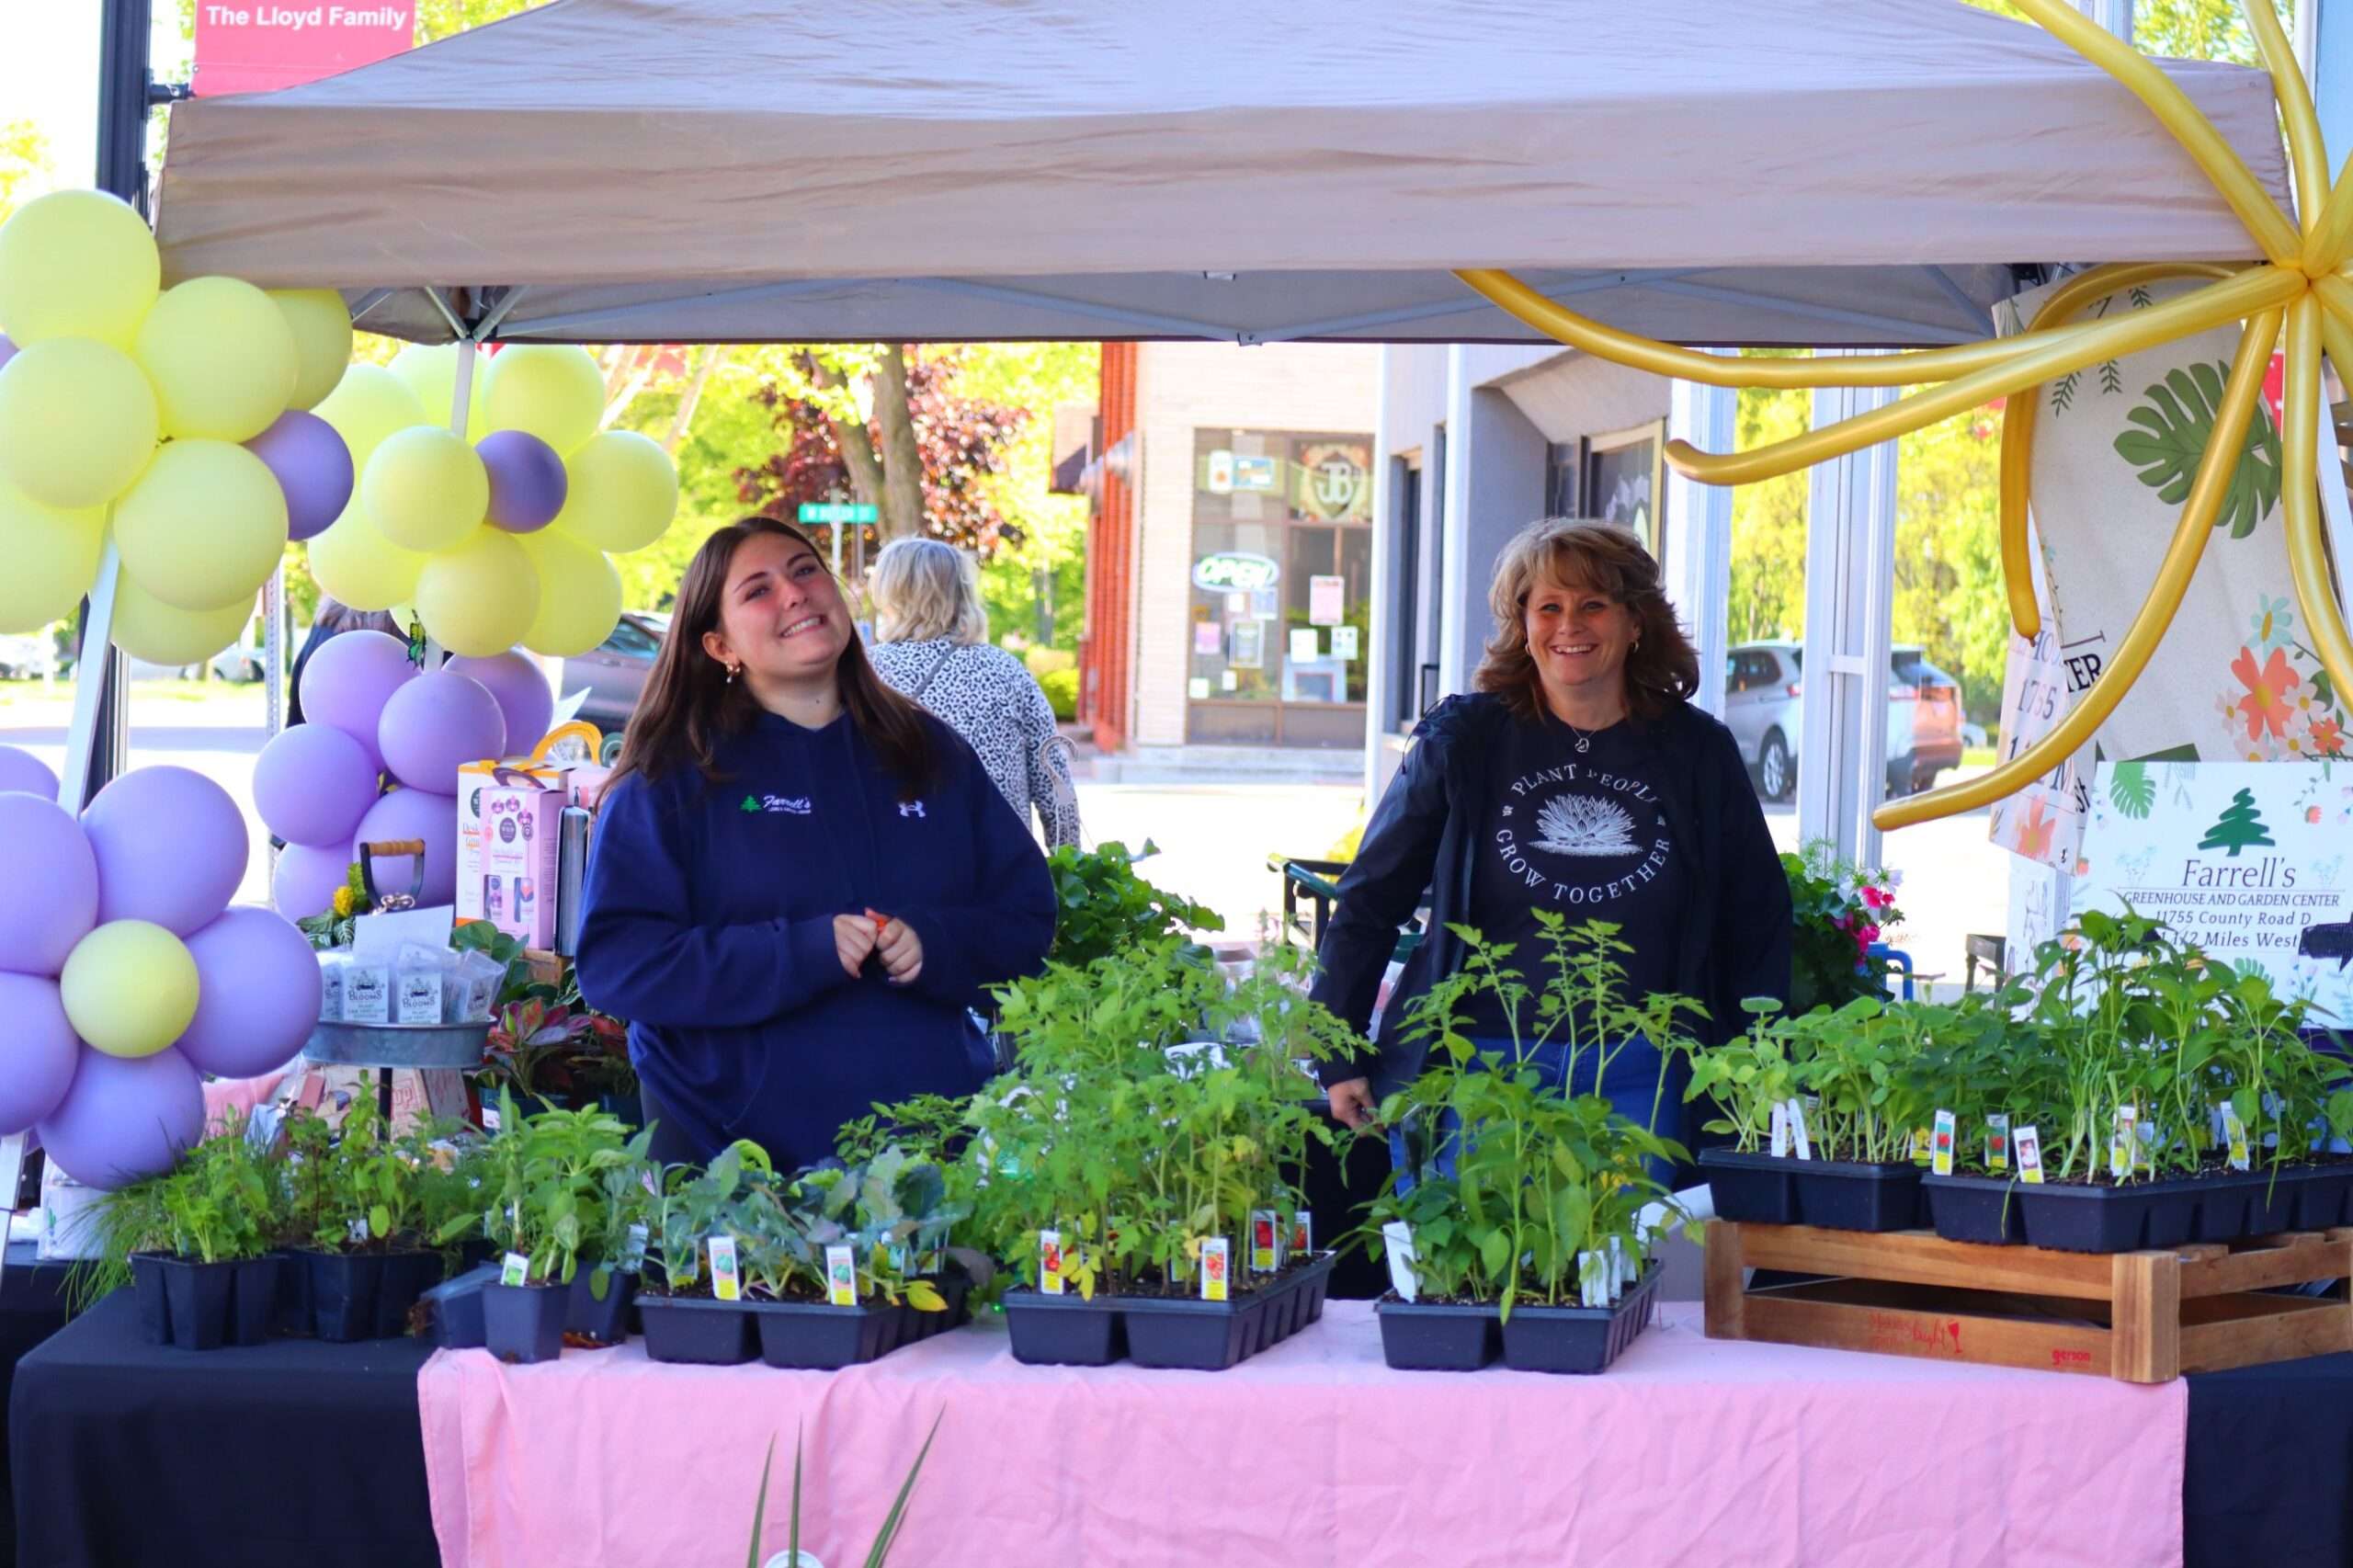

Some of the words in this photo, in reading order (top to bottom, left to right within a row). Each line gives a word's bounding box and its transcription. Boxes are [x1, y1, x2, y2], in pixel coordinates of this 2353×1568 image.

[206, 6, 250, 26] The
[256, 6, 321, 30] Lloyd
[328, 6, 407, 30] Family
[1197, 555, 1267, 589] OPEN
[1510, 763, 1577, 797] PLANT
[1495, 829, 1547, 888] GROW
[1553, 837, 1670, 903] TOGETHER
[2181, 857, 2296, 889] Farrell's
[2124, 892, 2205, 905] GREENHOUSE
[2207, 892, 2236, 905] AND
[2237, 893, 2291, 906] GARDEN
[2292, 894, 2340, 907] CENTER
[2156, 909, 2194, 924] 11755
[2199, 911, 2253, 928] County
[2257, 911, 2297, 925] Road
[2301, 913, 2312, 925] D
[2205, 932, 2249, 947] Miles
[2256, 932, 2298, 948] West
